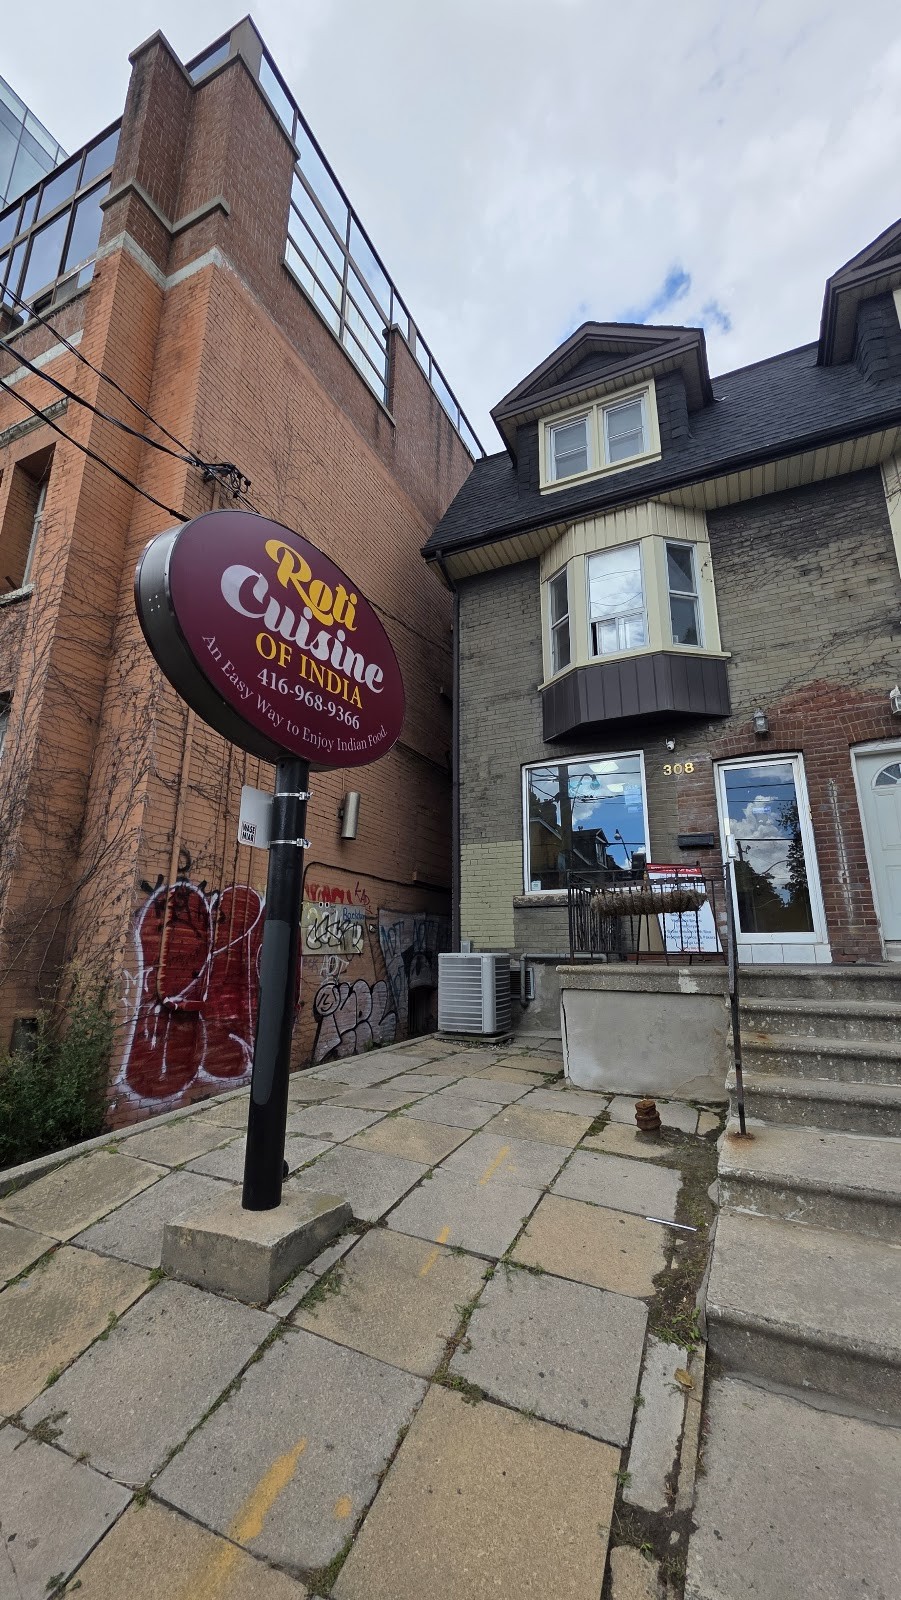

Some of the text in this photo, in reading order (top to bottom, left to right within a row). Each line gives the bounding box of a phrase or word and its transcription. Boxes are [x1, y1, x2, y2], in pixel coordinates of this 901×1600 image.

[264, 539, 358, 632] Roti
[220, 564, 385, 694] Cuisine
[255, 632, 364, 709] OF INDIA
[201, 636, 388, 753] An Easy Way to Enjoy Indian Food
[257, 668, 360, 730] 416-968-9366
[663, 762, 695, 776] 308
